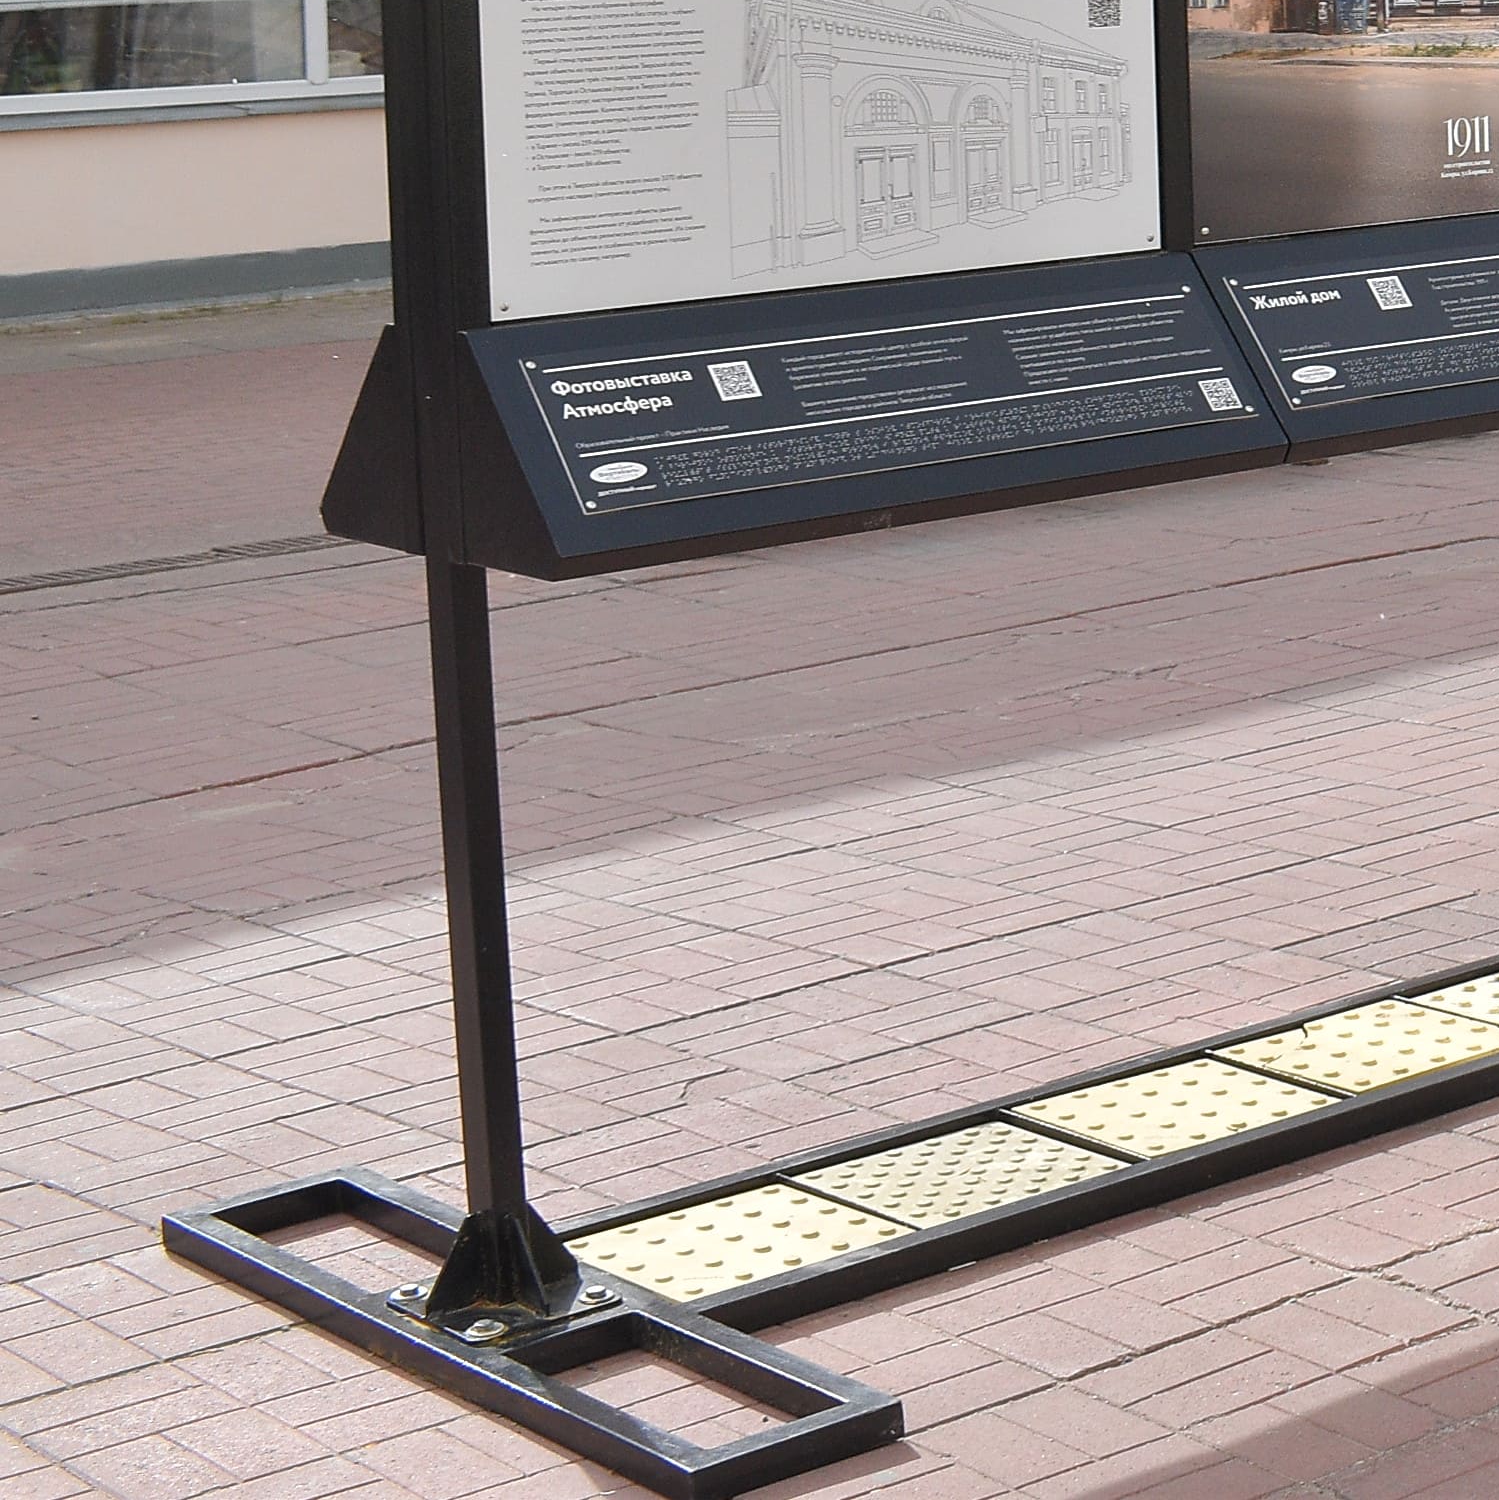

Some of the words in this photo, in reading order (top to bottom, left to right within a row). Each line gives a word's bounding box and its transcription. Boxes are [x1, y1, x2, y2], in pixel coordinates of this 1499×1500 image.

[1443, 115, 1490, 158] 1911
[1250, 290, 1309, 310] Жилой
[1311, 288, 1342, 304] дом
[550, 369, 694, 396] Фотовыставка
[562, 395, 673, 420] Атмосфера
